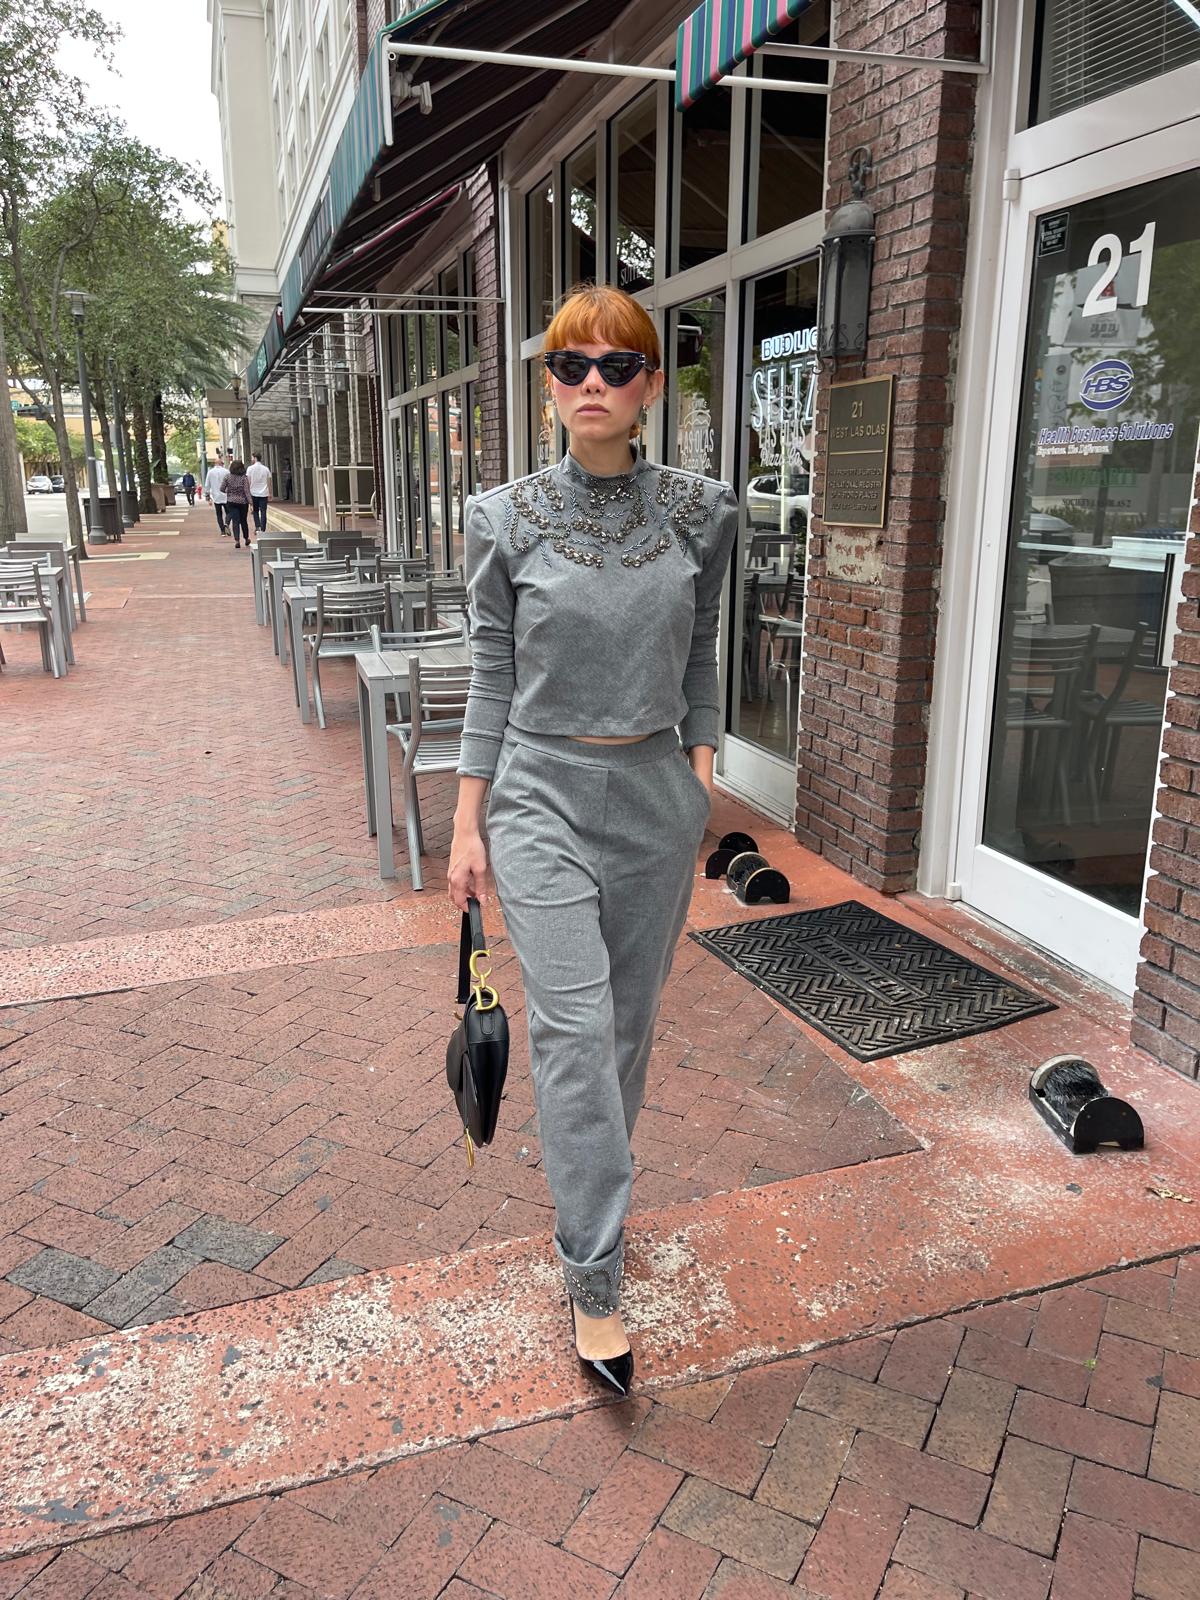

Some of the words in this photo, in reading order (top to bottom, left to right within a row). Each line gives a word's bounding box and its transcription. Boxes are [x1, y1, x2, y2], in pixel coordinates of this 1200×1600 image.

[1082, 221, 1156, 318] 21
[1081, 374, 1133, 395] HBS
[851, 399, 864, 418] 21
[695, 428, 714, 453] OLAS
[850, 425, 864, 438] LAS
[866, 423, 886, 436] OLAS
[1038, 427, 1070, 446] Health
[1070, 424, 1118, 444] Business
[1118, 420, 1175, 442] Solutions
